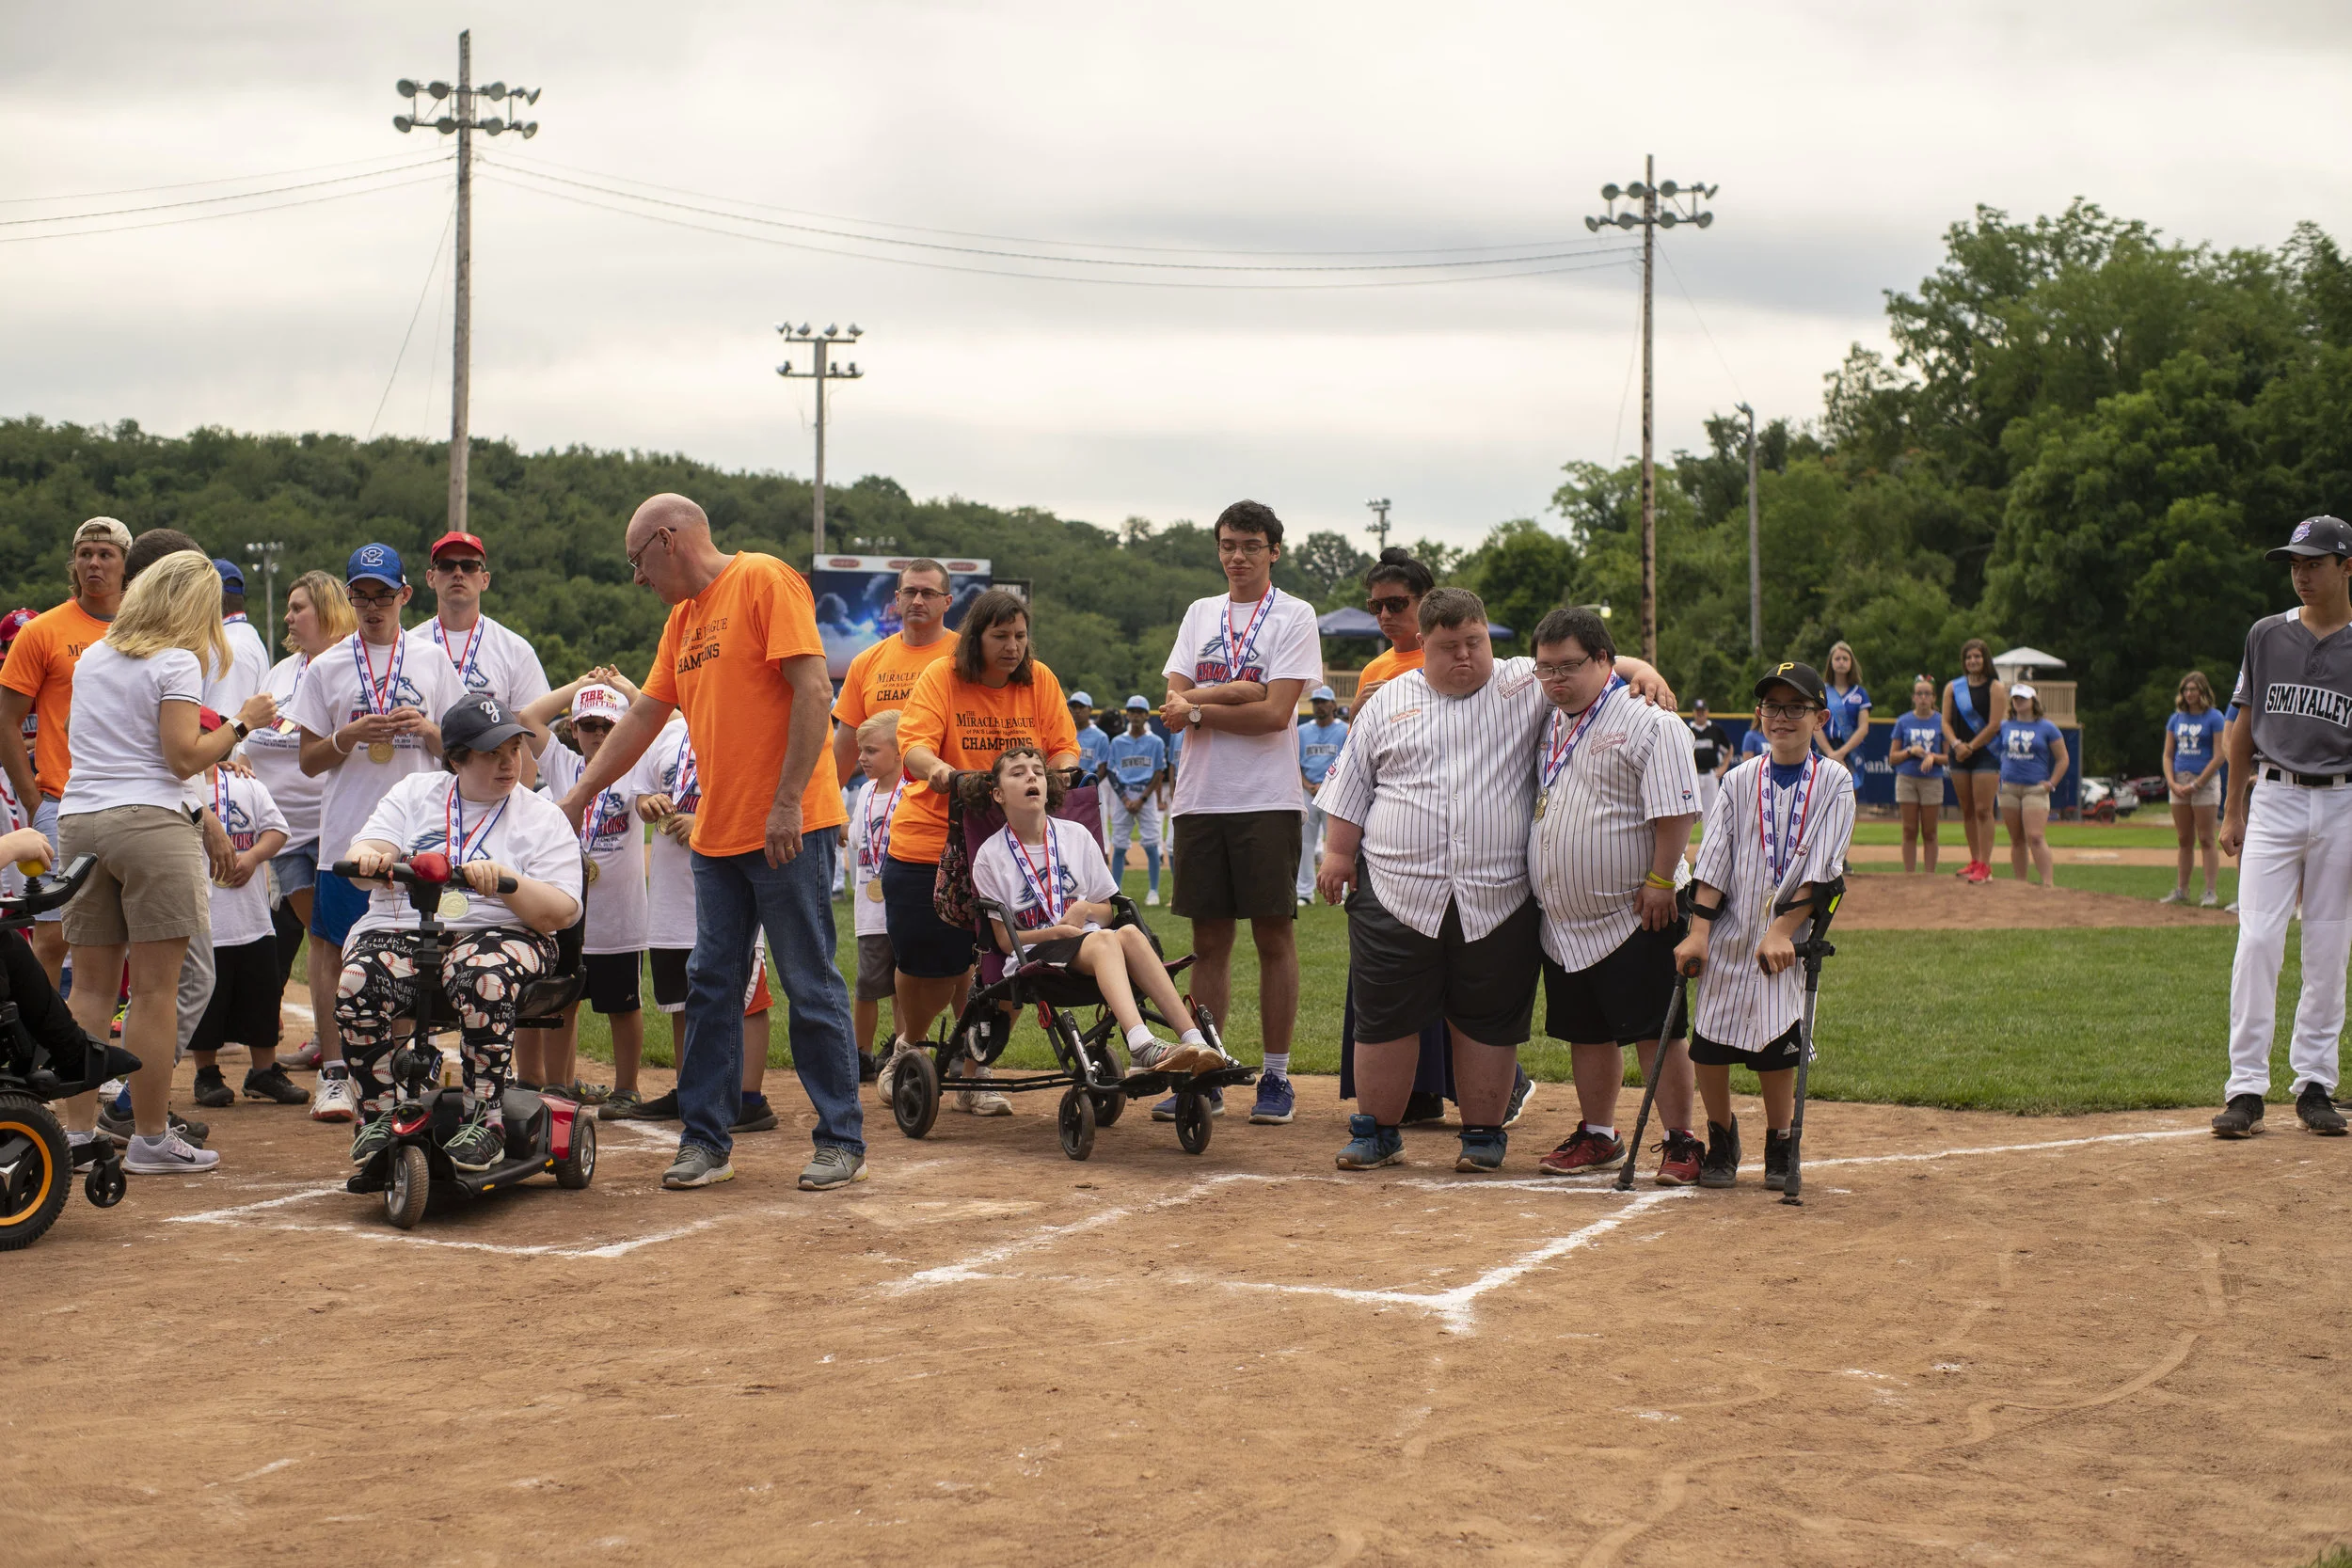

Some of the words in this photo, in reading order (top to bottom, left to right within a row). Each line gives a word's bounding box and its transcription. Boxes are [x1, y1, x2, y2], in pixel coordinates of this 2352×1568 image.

[1777, 662, 1794, 675] P
[2266, 685, 2296, 712] SIMI
[2297, 687, 2352, 725] VALLEY
[956, 713, 999, 728] MIRACLE
[1000, 717, 1035, 728] LEAGUE
[961, 736, 1033, 751] CHAMPIONS
[1864, 755, 1894, 774] ank
